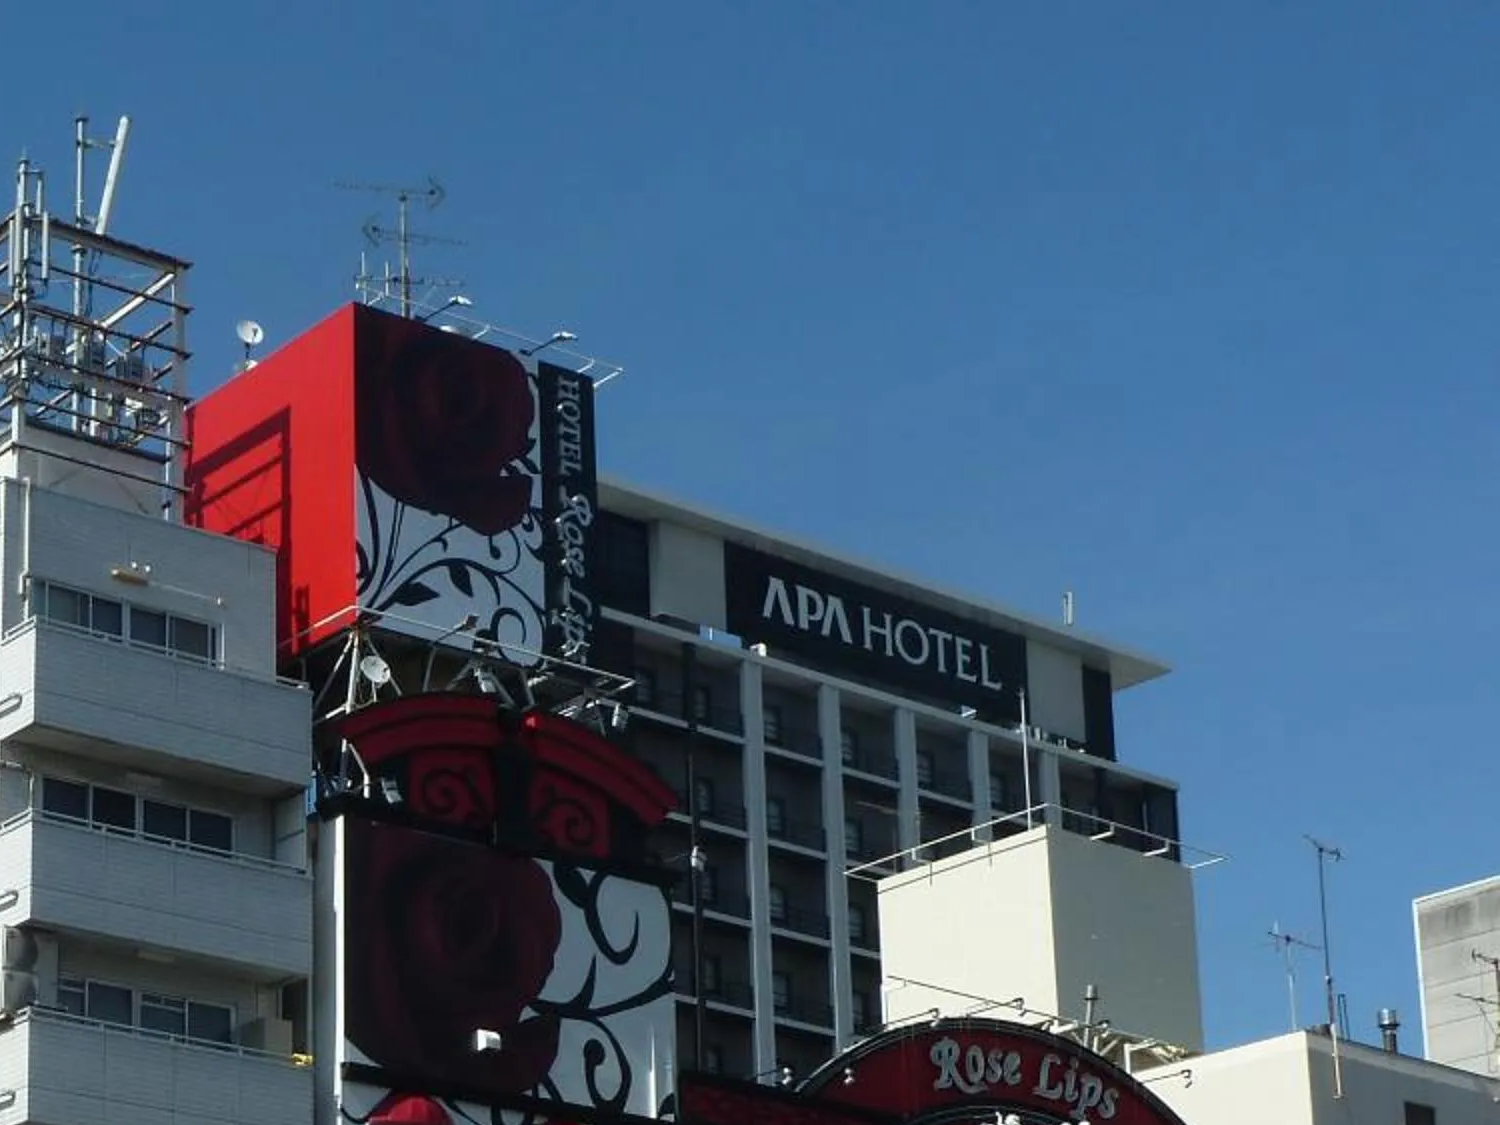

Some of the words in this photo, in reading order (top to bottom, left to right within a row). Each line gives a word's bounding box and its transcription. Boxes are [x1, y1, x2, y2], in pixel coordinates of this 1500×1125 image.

[558, 375, 583, 477] HOTEL
[557, 485, 594, 579] Rose
[762, 575, 853, 645] APA
[862, 605, 1003, 691] HOTEL
[929, 1036, 1023, 1095] Rose
[1031, 1053, 1120, 1121] Lips
